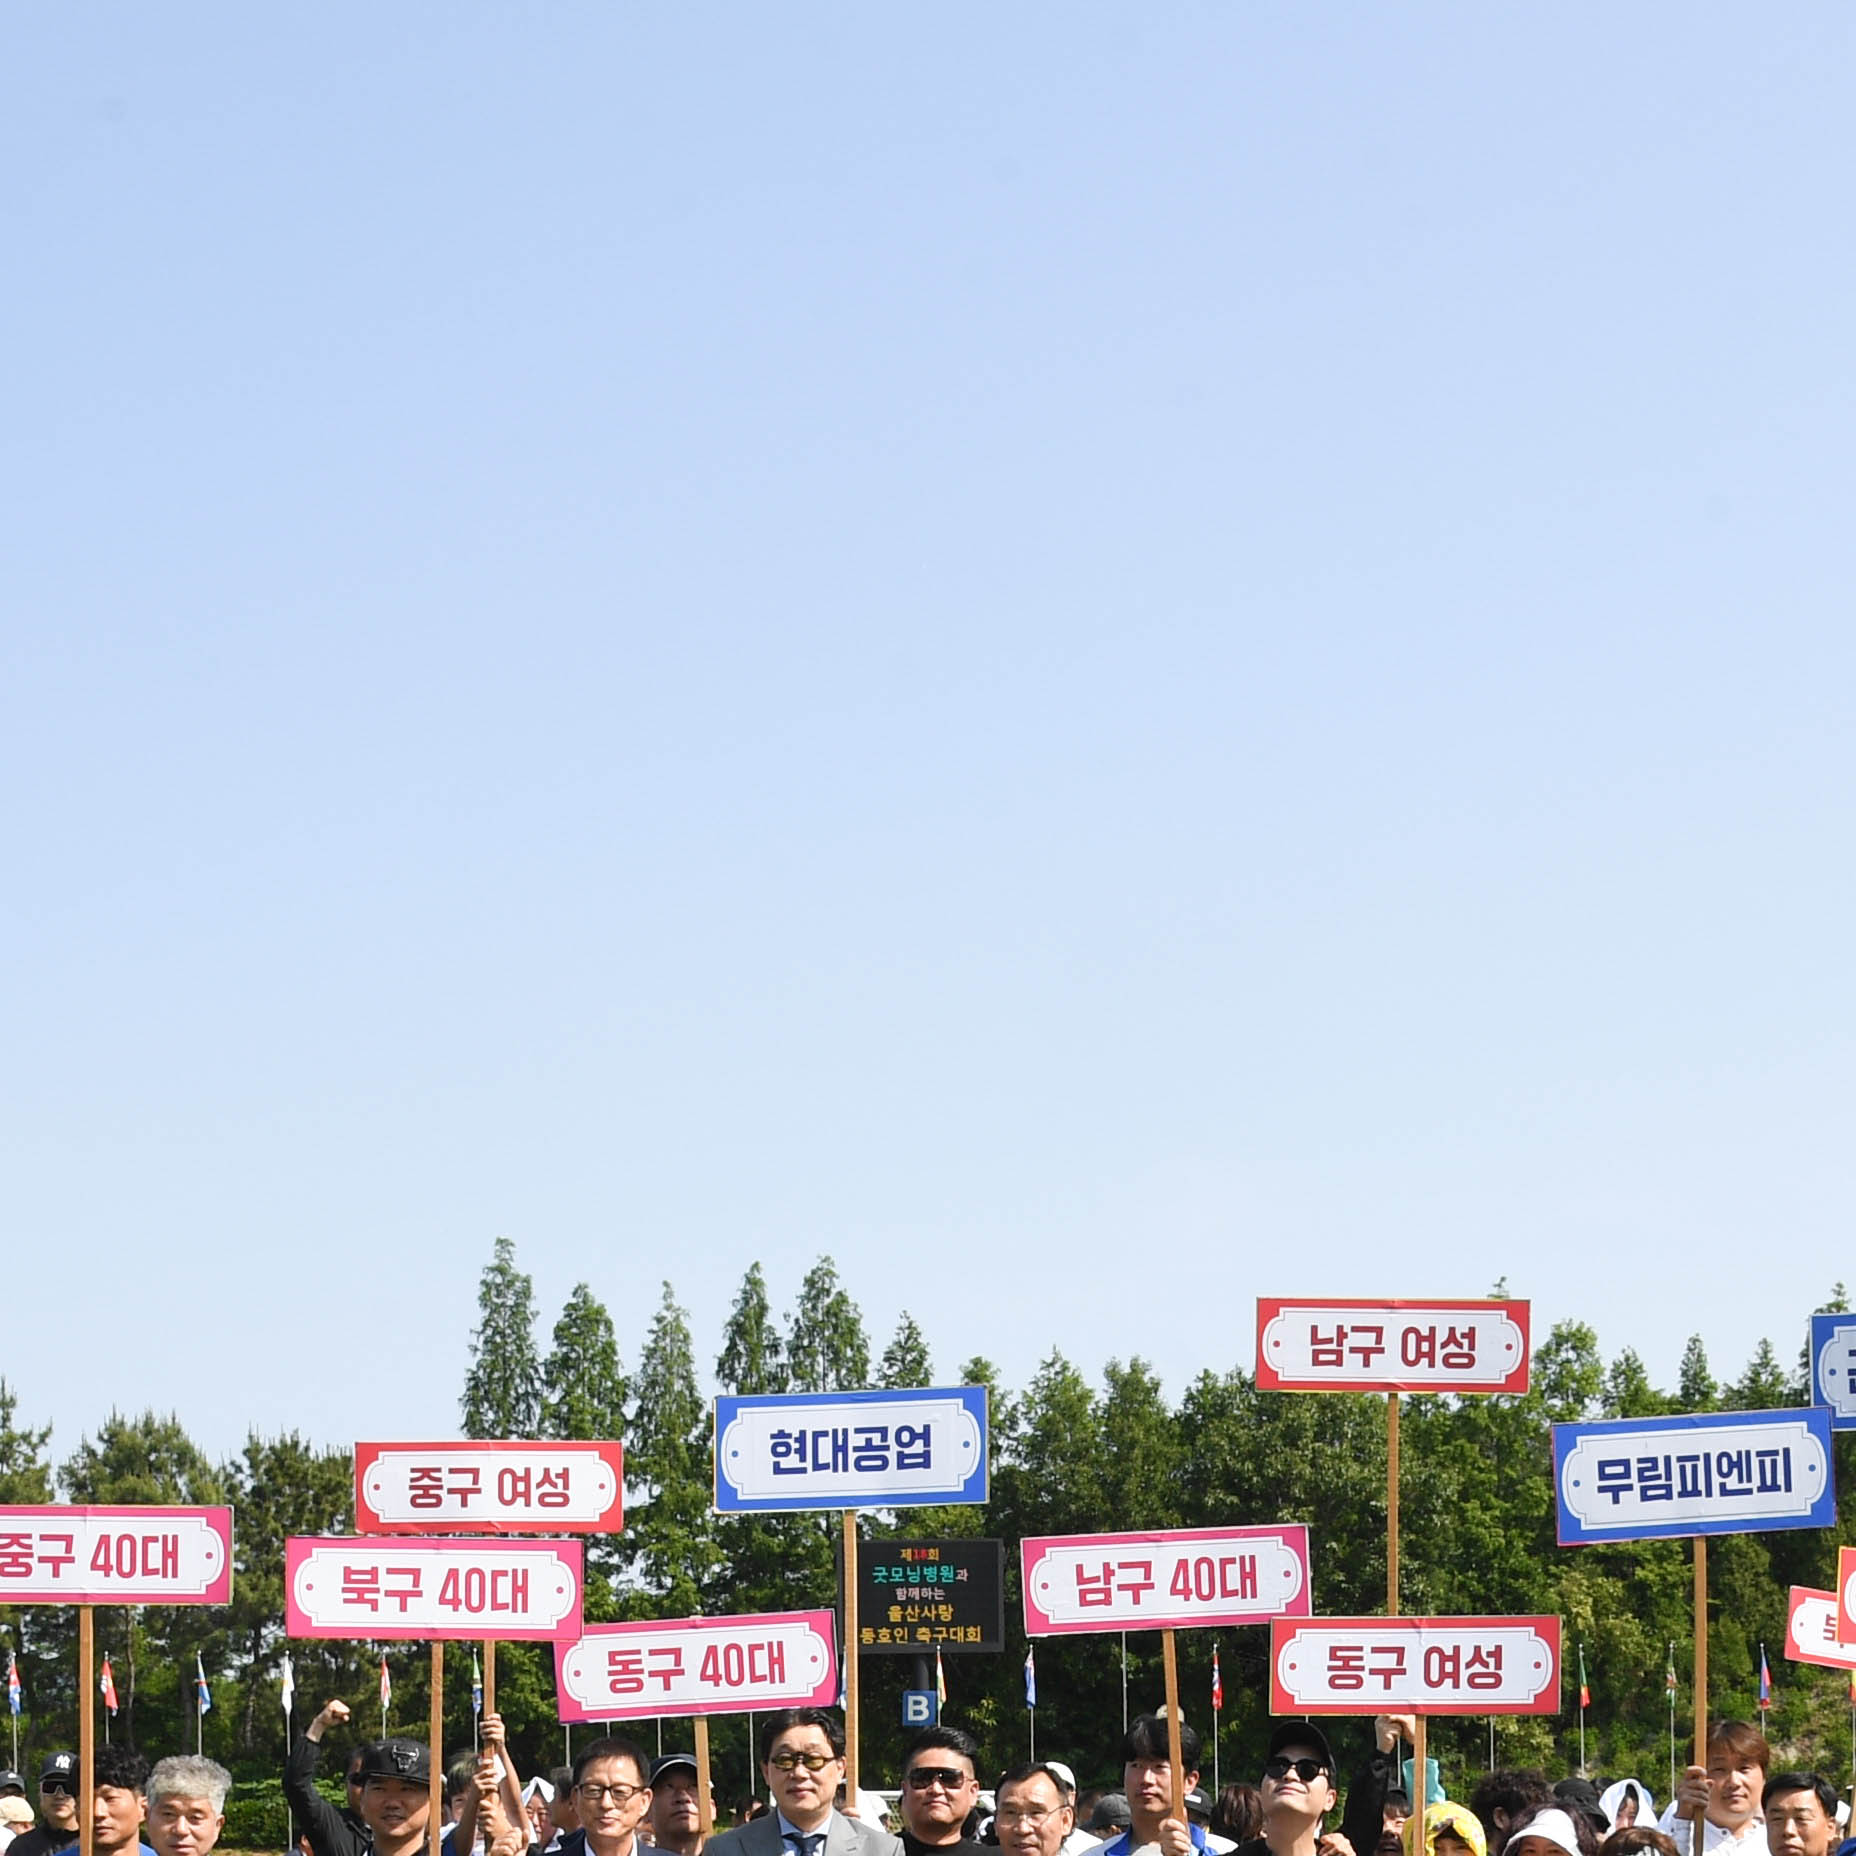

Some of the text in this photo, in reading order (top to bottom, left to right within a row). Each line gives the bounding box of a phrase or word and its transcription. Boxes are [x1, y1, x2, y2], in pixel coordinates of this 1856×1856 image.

[1311, 1325, 1475, 1369] 남구 여성
[770, 1424, 931, 1475] 현대공업
[409, 1467, 570, 1508] 중구 여성
[1597, 1447, 1792, 1504] 무림피엔피
[90, 1534, 178, 1578] 40대
[342, 1566, 528, 1613] 북구 40대
[895, 1587, 946, 1600] 함께하는
[1076, 1555, 1257, 1607] 남구 40대
[888, 1604, 954, 1622] 울산사랑
[860, 1626, 981, 1645] 동호인 축구대회
[608, 1641, 785, 1693] 동구 40대
[1327, 1645, 1502, 1690] 동구 여성
[907, 1695, 929, 1721] B
